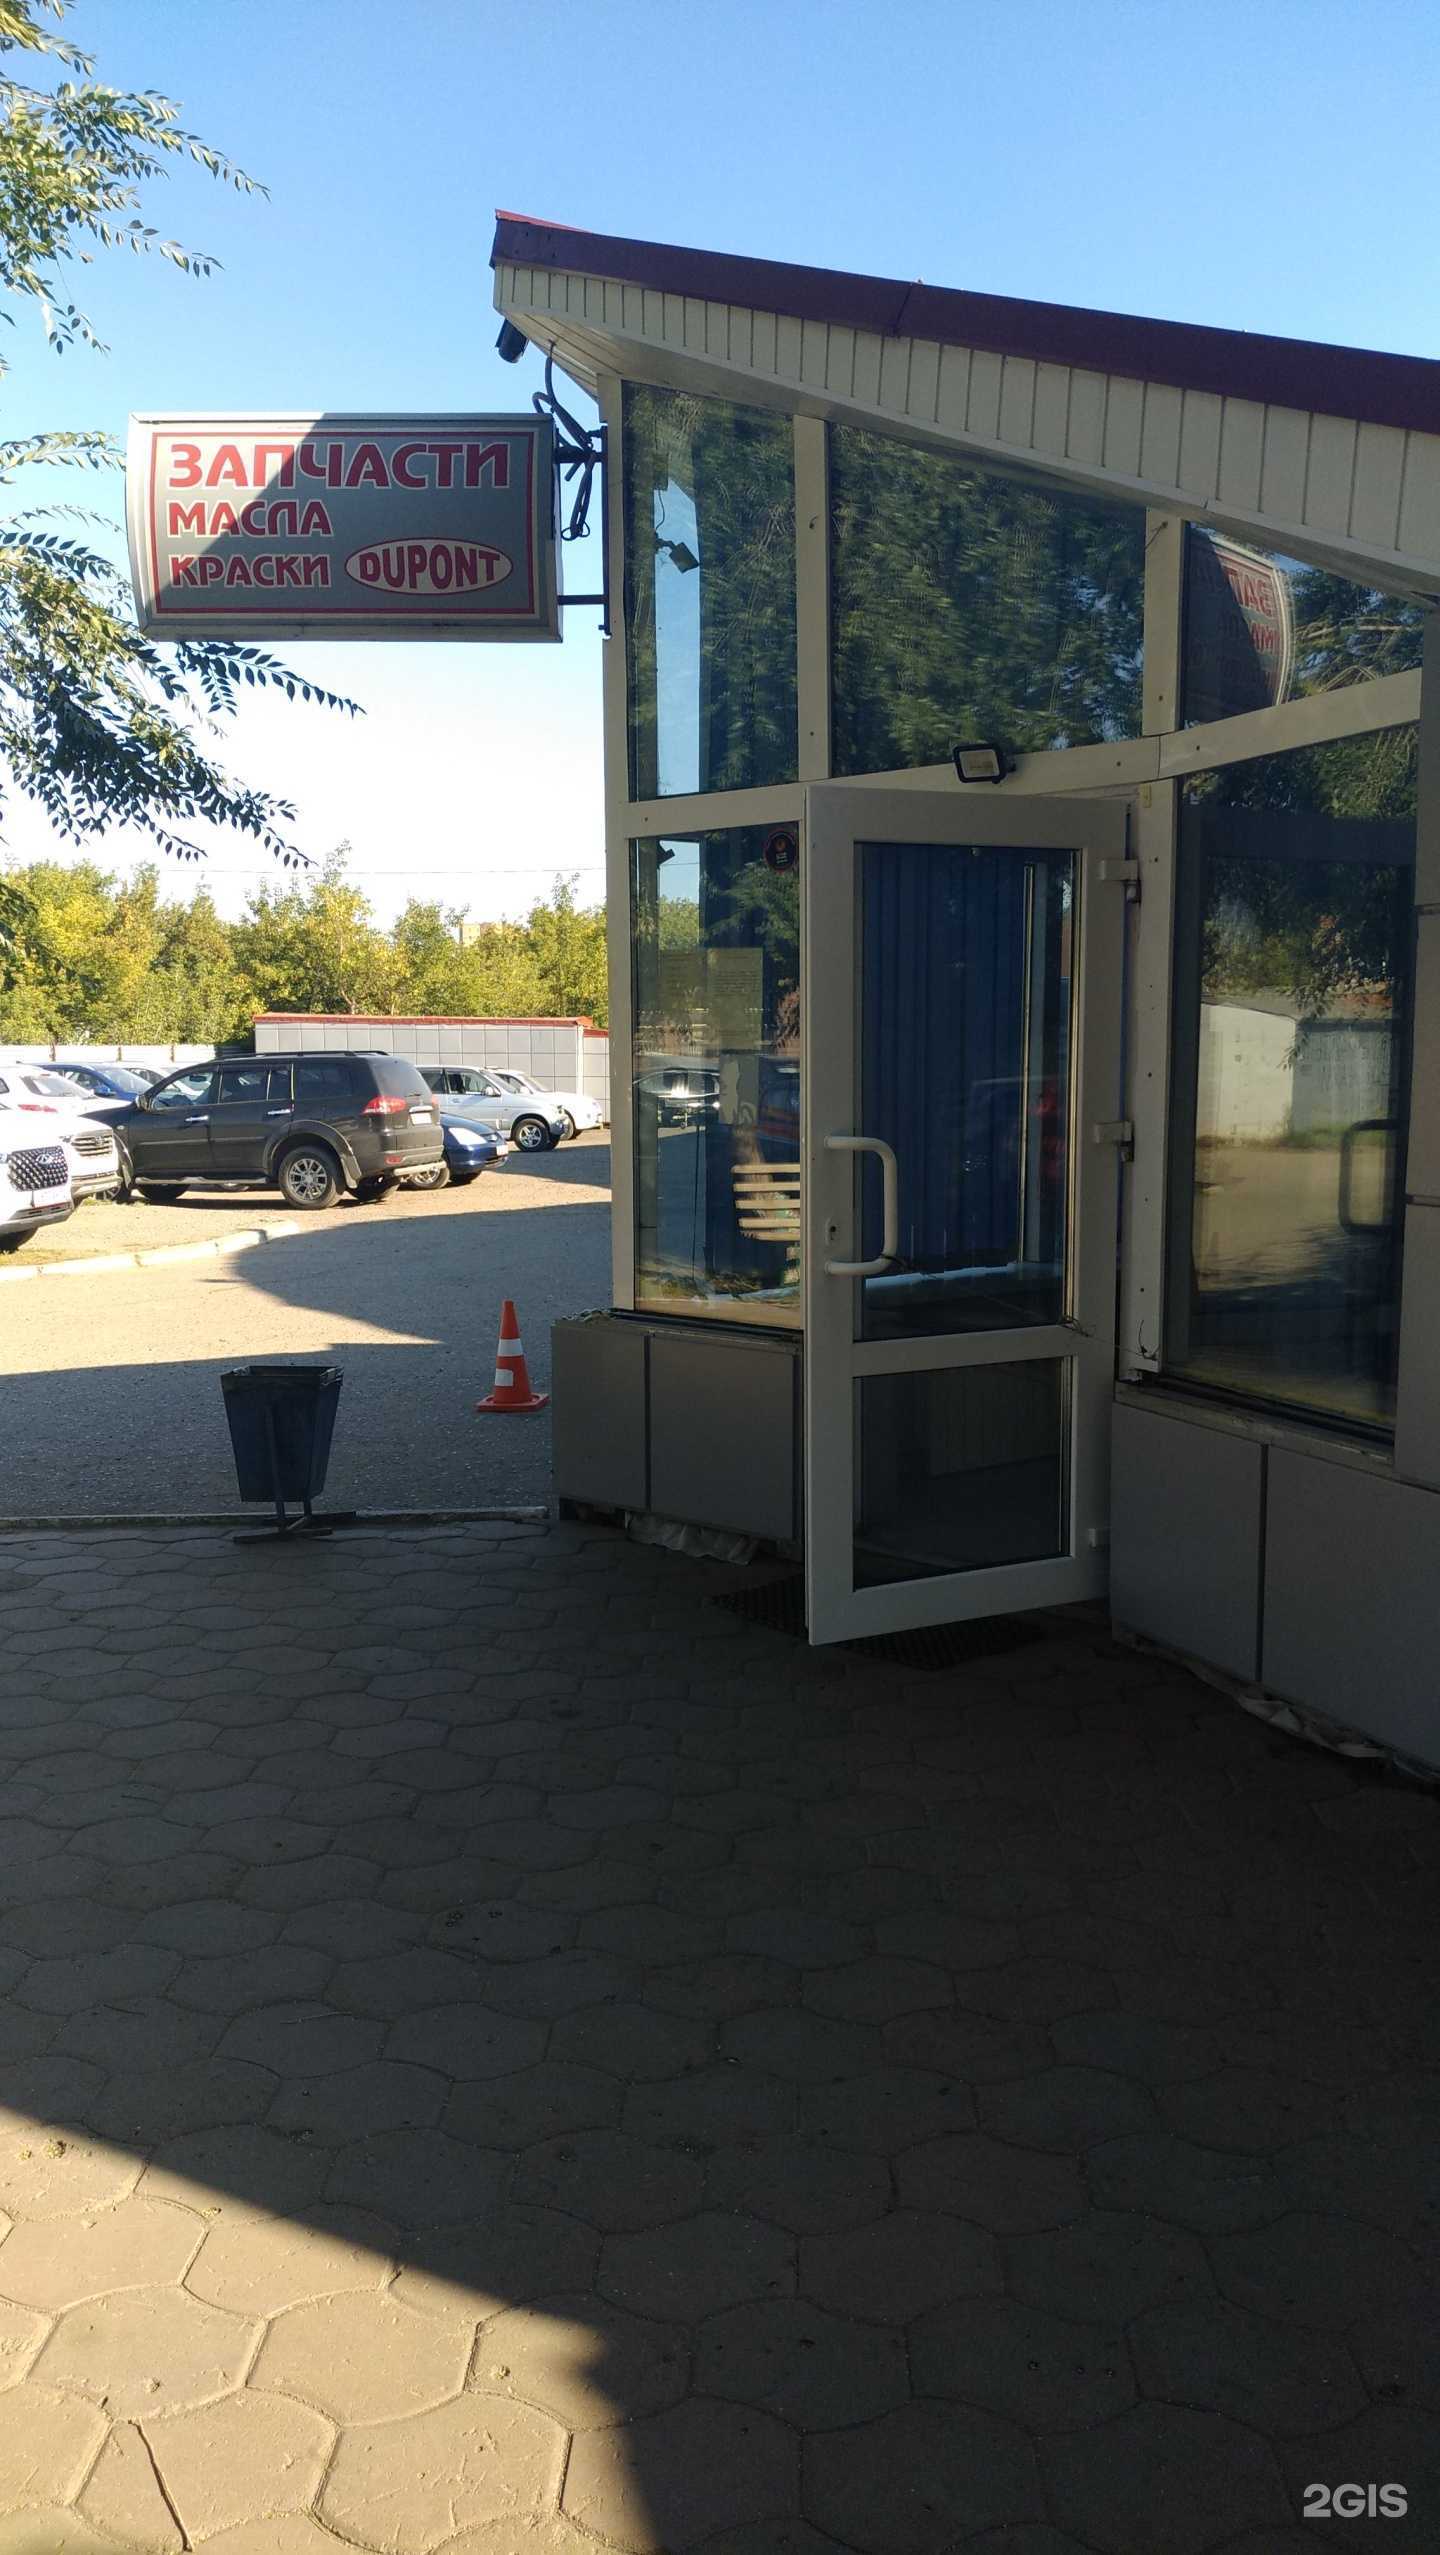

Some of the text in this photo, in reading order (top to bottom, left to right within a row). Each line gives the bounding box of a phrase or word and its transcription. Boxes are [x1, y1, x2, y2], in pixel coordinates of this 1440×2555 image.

[168, 442, 510, 489] ЗАПЧАСТИ
[167, 500, 334, 538] МАСЛА
[169, 554, 331, 588] КРАСКИ
[358, 544, 500, 589] DUPONT
